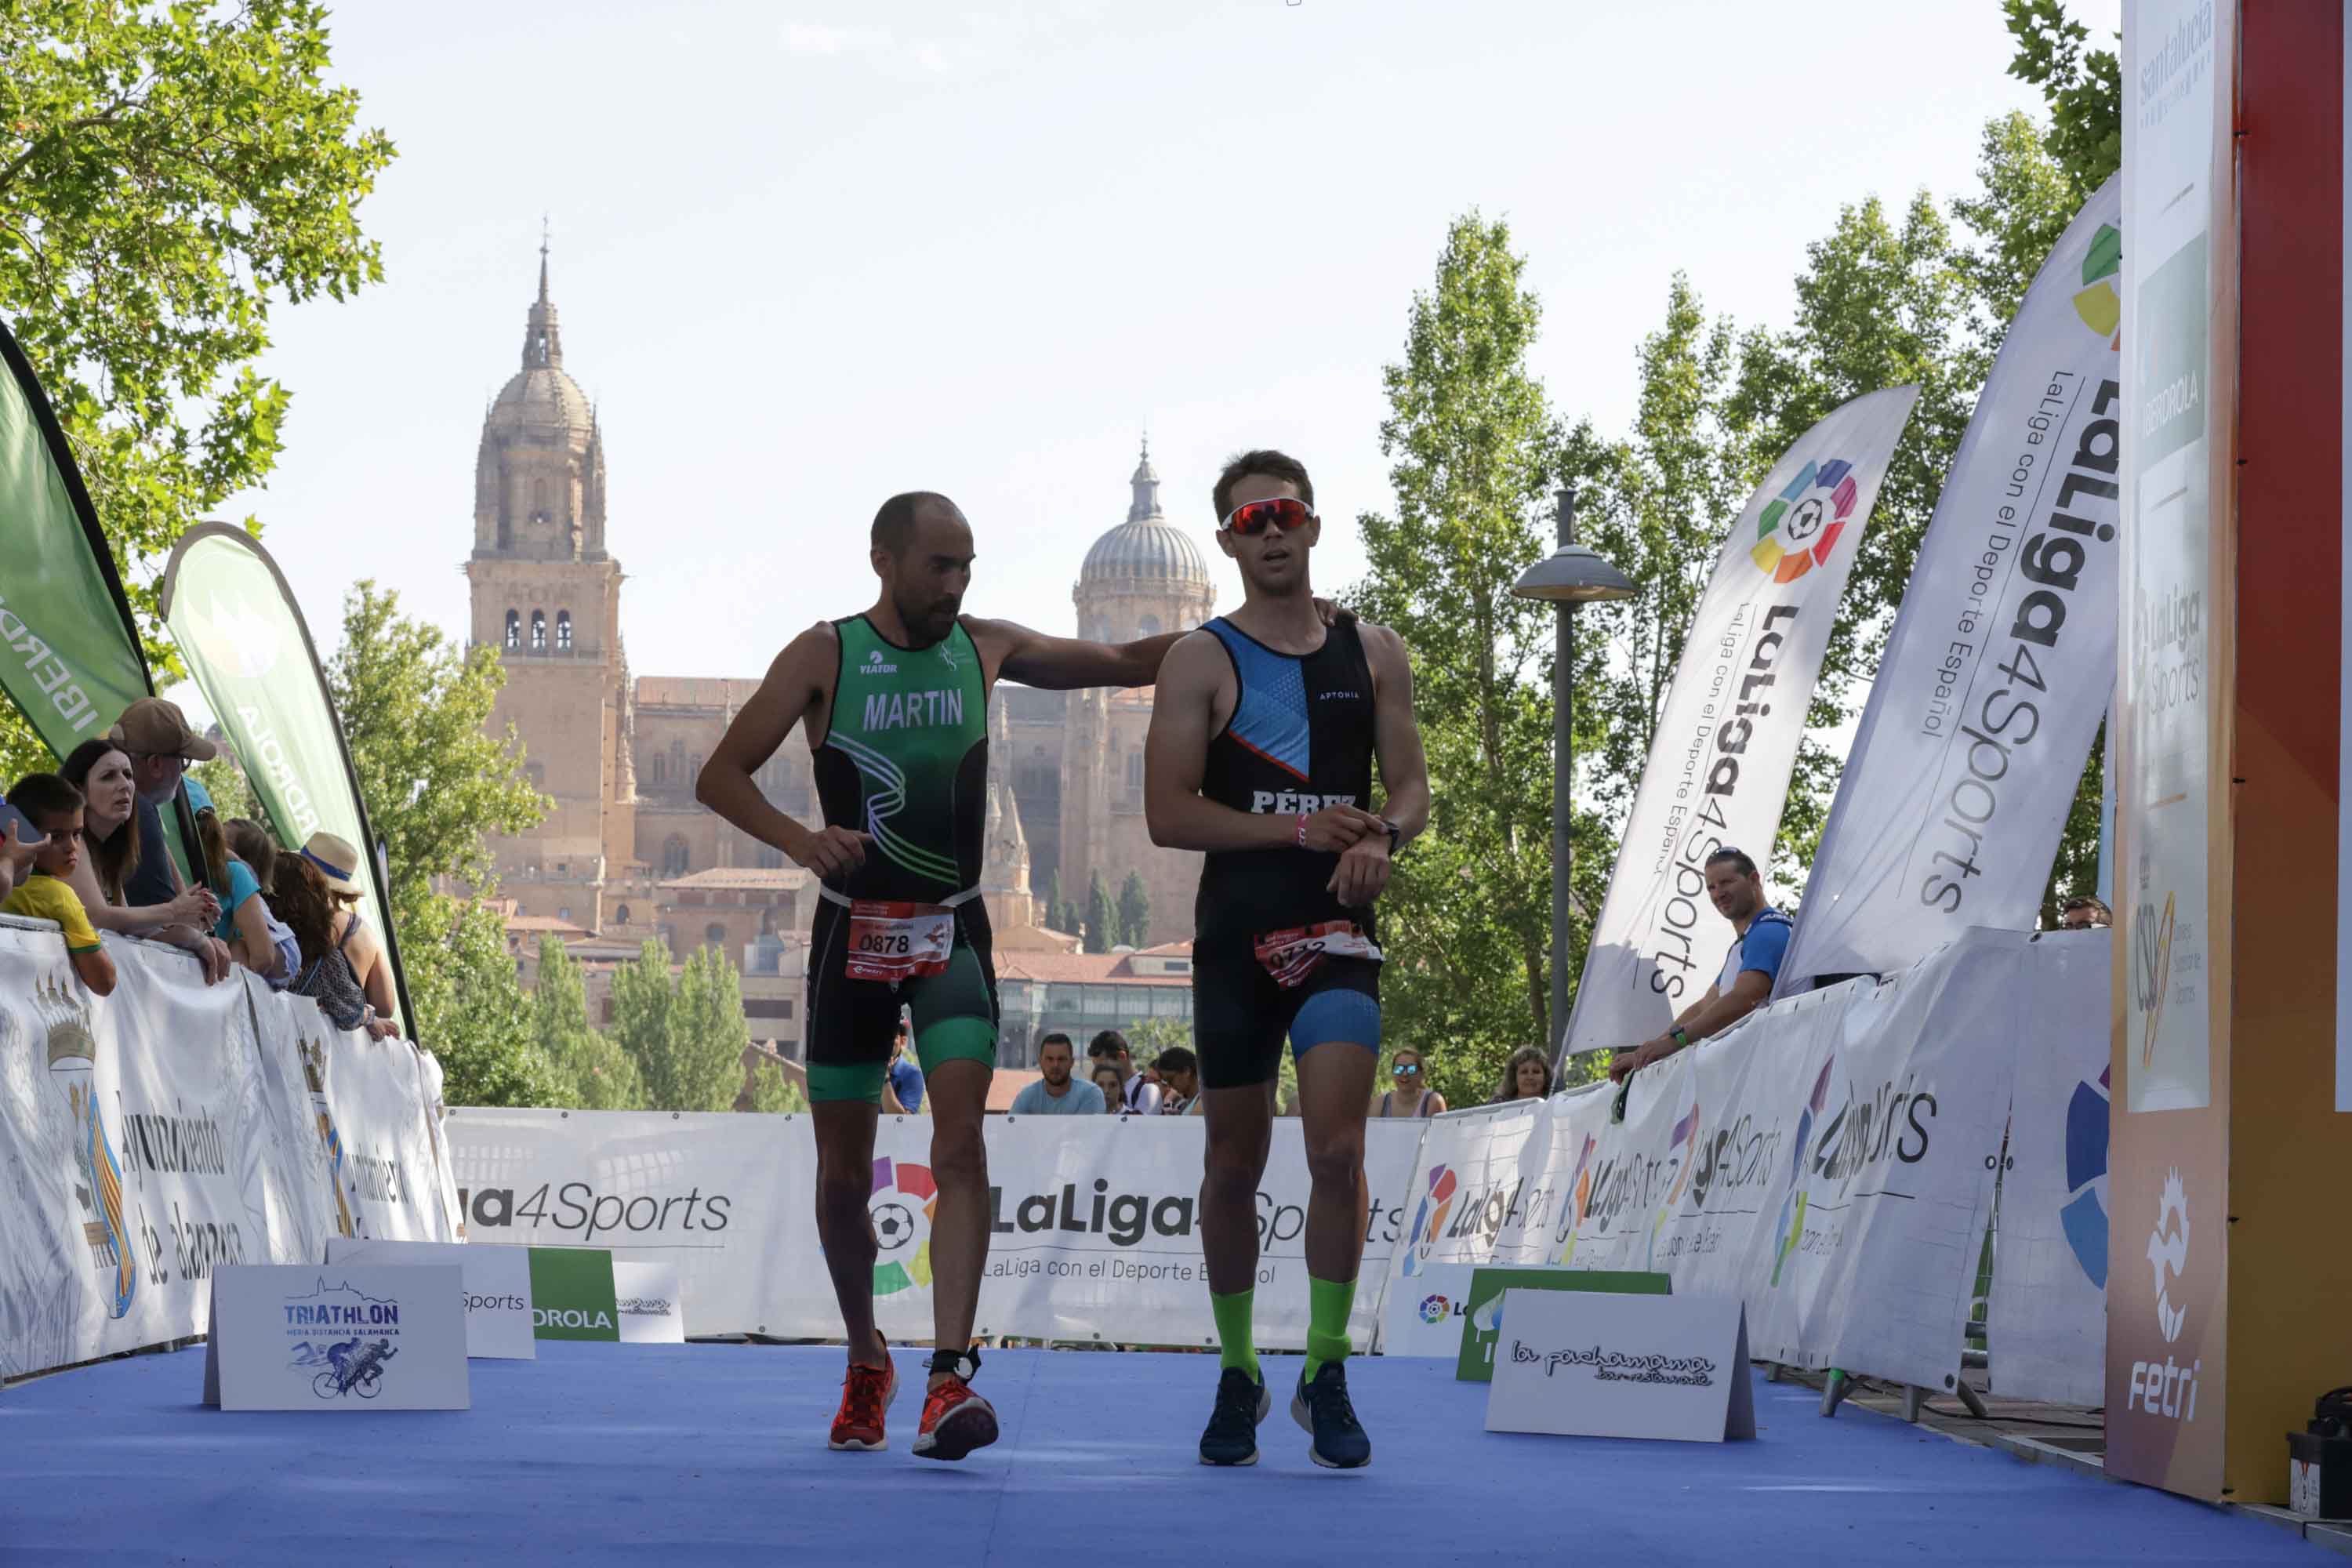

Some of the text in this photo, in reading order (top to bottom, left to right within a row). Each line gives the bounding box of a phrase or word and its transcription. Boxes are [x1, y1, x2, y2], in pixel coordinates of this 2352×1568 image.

[2144, 370, 2198, 437] IBERDROLA
[1922, 370, 2074, 739] LaLiga con el Deporte Español
[1920, 379, 2120, 914] LaLiga4Sports
[860, 664, 898, 674] VIATOR
[1709, 665, 1728, 698] con
[863, 688, 964, 731] MARTIN
[1319, 691, 1360, 700] APTONIA
[1701, 702, 1715, 721] el
[1675, 725, 1711, 799] Deporte
[1650, 604, 1800, 999] LaLiga4Sports
[859, 934, 909, 953] 0878
[984, 1257, 1040, 1278] LaLiga
[1047, 1261, 1082, 1276] con
[1089, 1260, 1105, 1277] el
[1112, 1259, 1192, 1283] Deporte
[284, 1304, 398, 1325] TRIATHLON
[1511, 1340, 1541, 1363] la
[1544, 1345, 1716, 1377] pachamama
[1593, 1366, 1714, 1386] bar-restaurante
